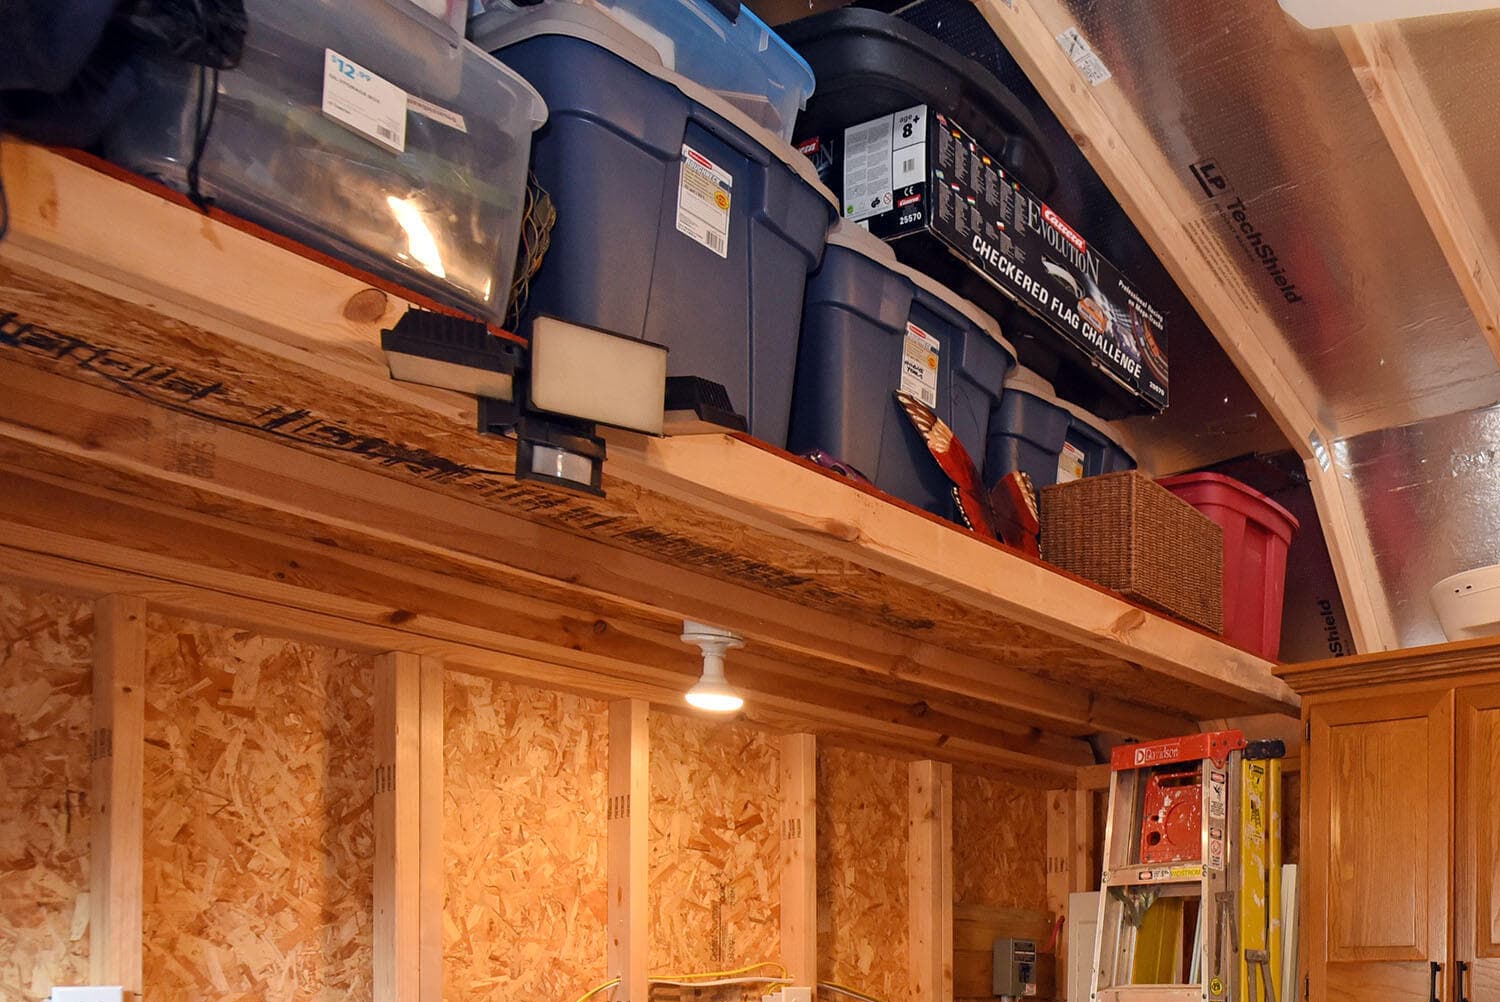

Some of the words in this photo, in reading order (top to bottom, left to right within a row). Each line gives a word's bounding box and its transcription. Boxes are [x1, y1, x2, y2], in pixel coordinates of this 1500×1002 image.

[1027, 198, 1099, 285] EVOLUTION
[1044, 209, 1084, 249] Carrera
[1200, 163, 1226, 190] LP
[1227, 197, 1302, 304] TechShield
[972, 235, 1049, 304] CHECKERED
[1051, 296, 1079, 329] FLAG
[1082, 322, 1142, 378] CHALLENGE
